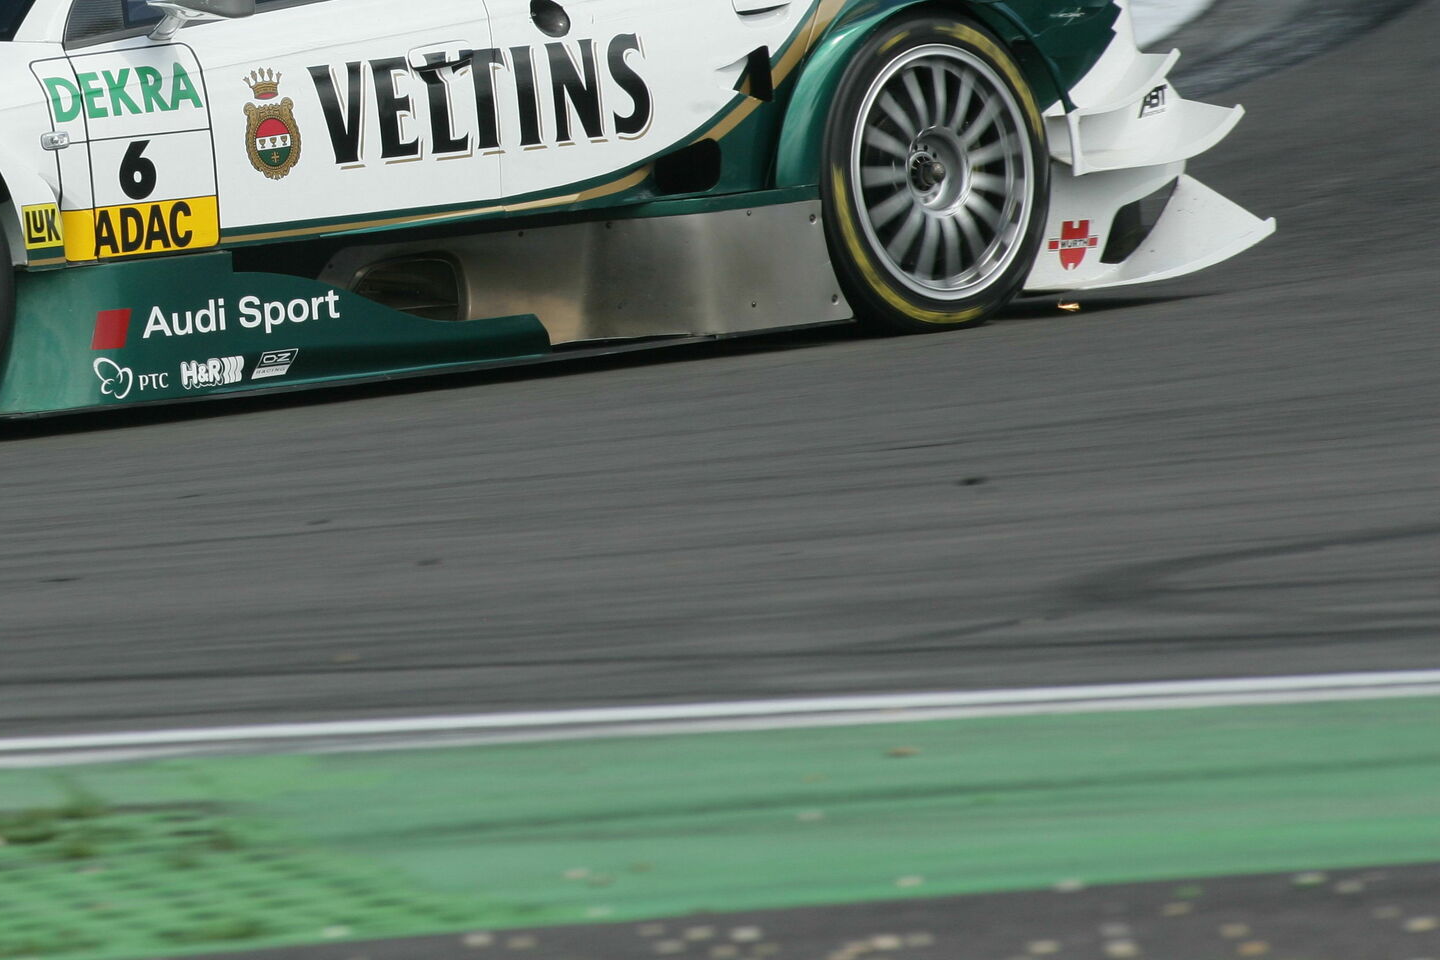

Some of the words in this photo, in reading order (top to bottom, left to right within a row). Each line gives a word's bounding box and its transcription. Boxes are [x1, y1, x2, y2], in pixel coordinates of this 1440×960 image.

[43, 62, 204, 123] DEKRA
[307, 32, 655, 170] VELTINS
[1137, 84, 1168, 119] ABT
[119, 140, 157, 200] 6
[94, 201, 193, 257] ADAC
[142, 298, 226, 339] Audi
[238, 290, 340, 334] Sport
[138, 372, 169, 390] PTC
